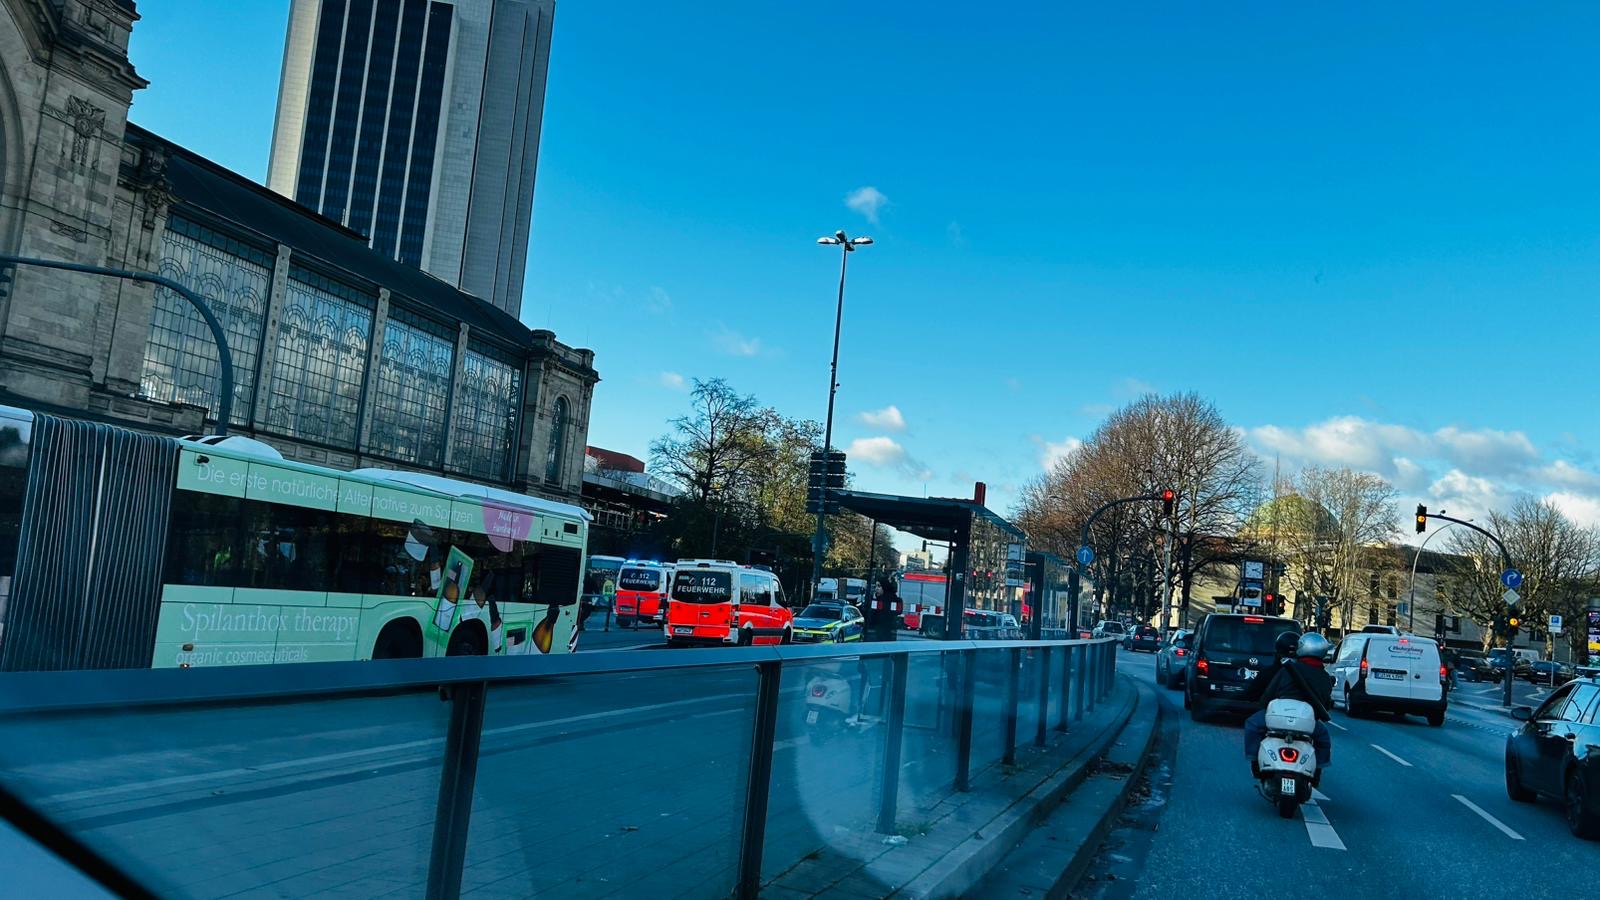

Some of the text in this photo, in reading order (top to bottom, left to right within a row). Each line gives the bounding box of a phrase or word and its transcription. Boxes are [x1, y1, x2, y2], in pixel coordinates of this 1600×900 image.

[197, 464, 225, 483] Die
[230, 471, 267, 490] erste
[271, 478, 342, 502] natürliche
[344, 488, 408, 514] Alternative
[409, 504, 433, 518] zum
[677, 585, 725, 594] FEUERWEHR
[702, 577, 716, 586] 112
[181, 603, 358, 641] Spilanthox therapy
[175, 647, 308, 666] organic cosmeceuticals
